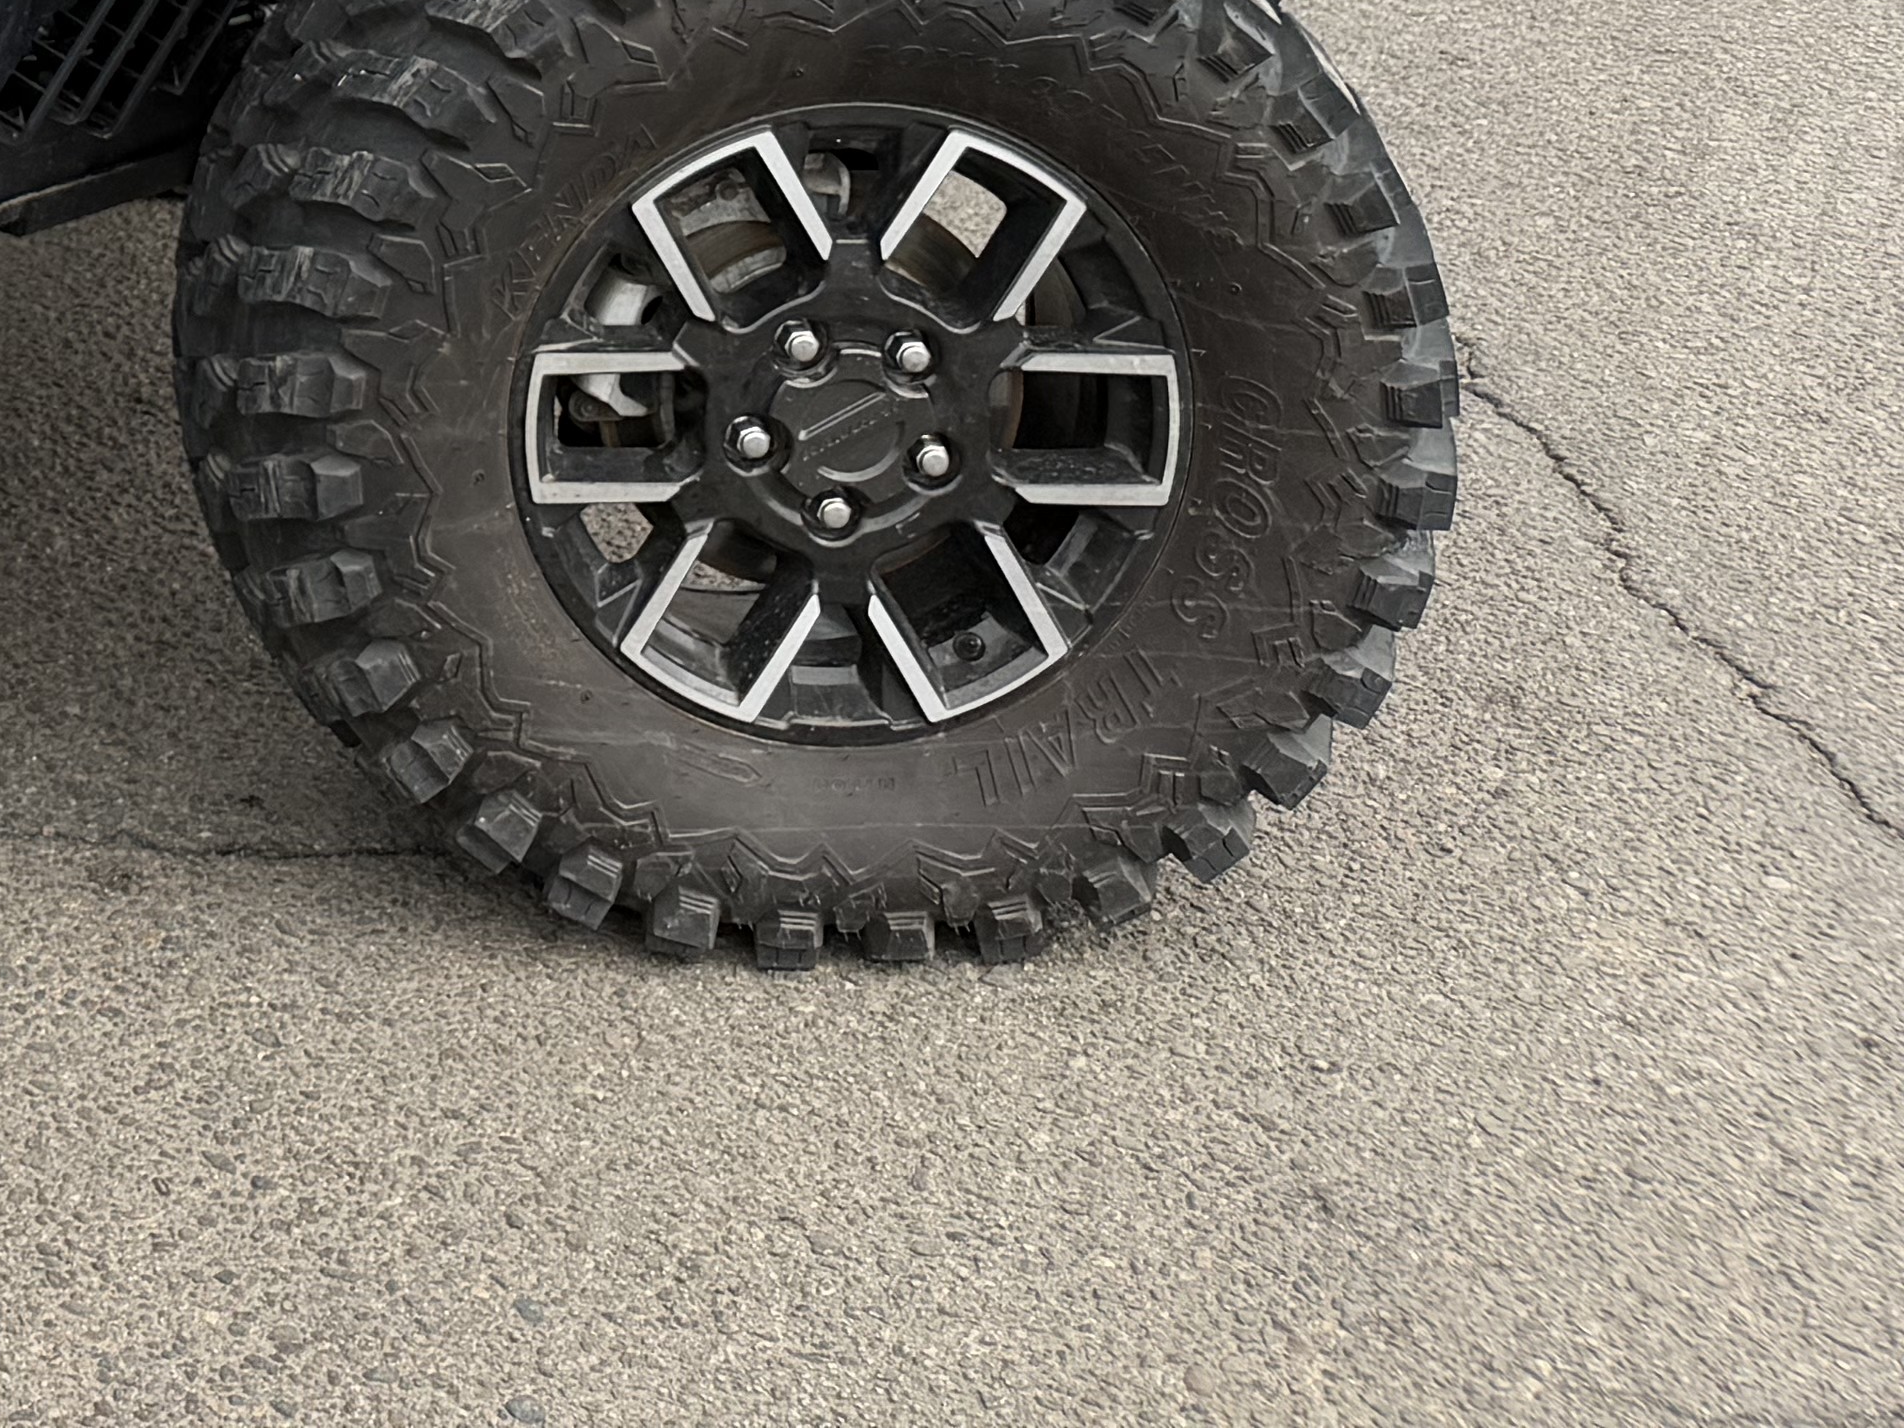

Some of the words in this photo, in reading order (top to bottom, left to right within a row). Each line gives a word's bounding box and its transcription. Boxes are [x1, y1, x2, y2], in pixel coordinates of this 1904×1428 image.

[493, 122, 658, 321] KENDA
[1169, 374, 1283, 639] CROSS
[953, 648, 1182, 807] TRAIL
